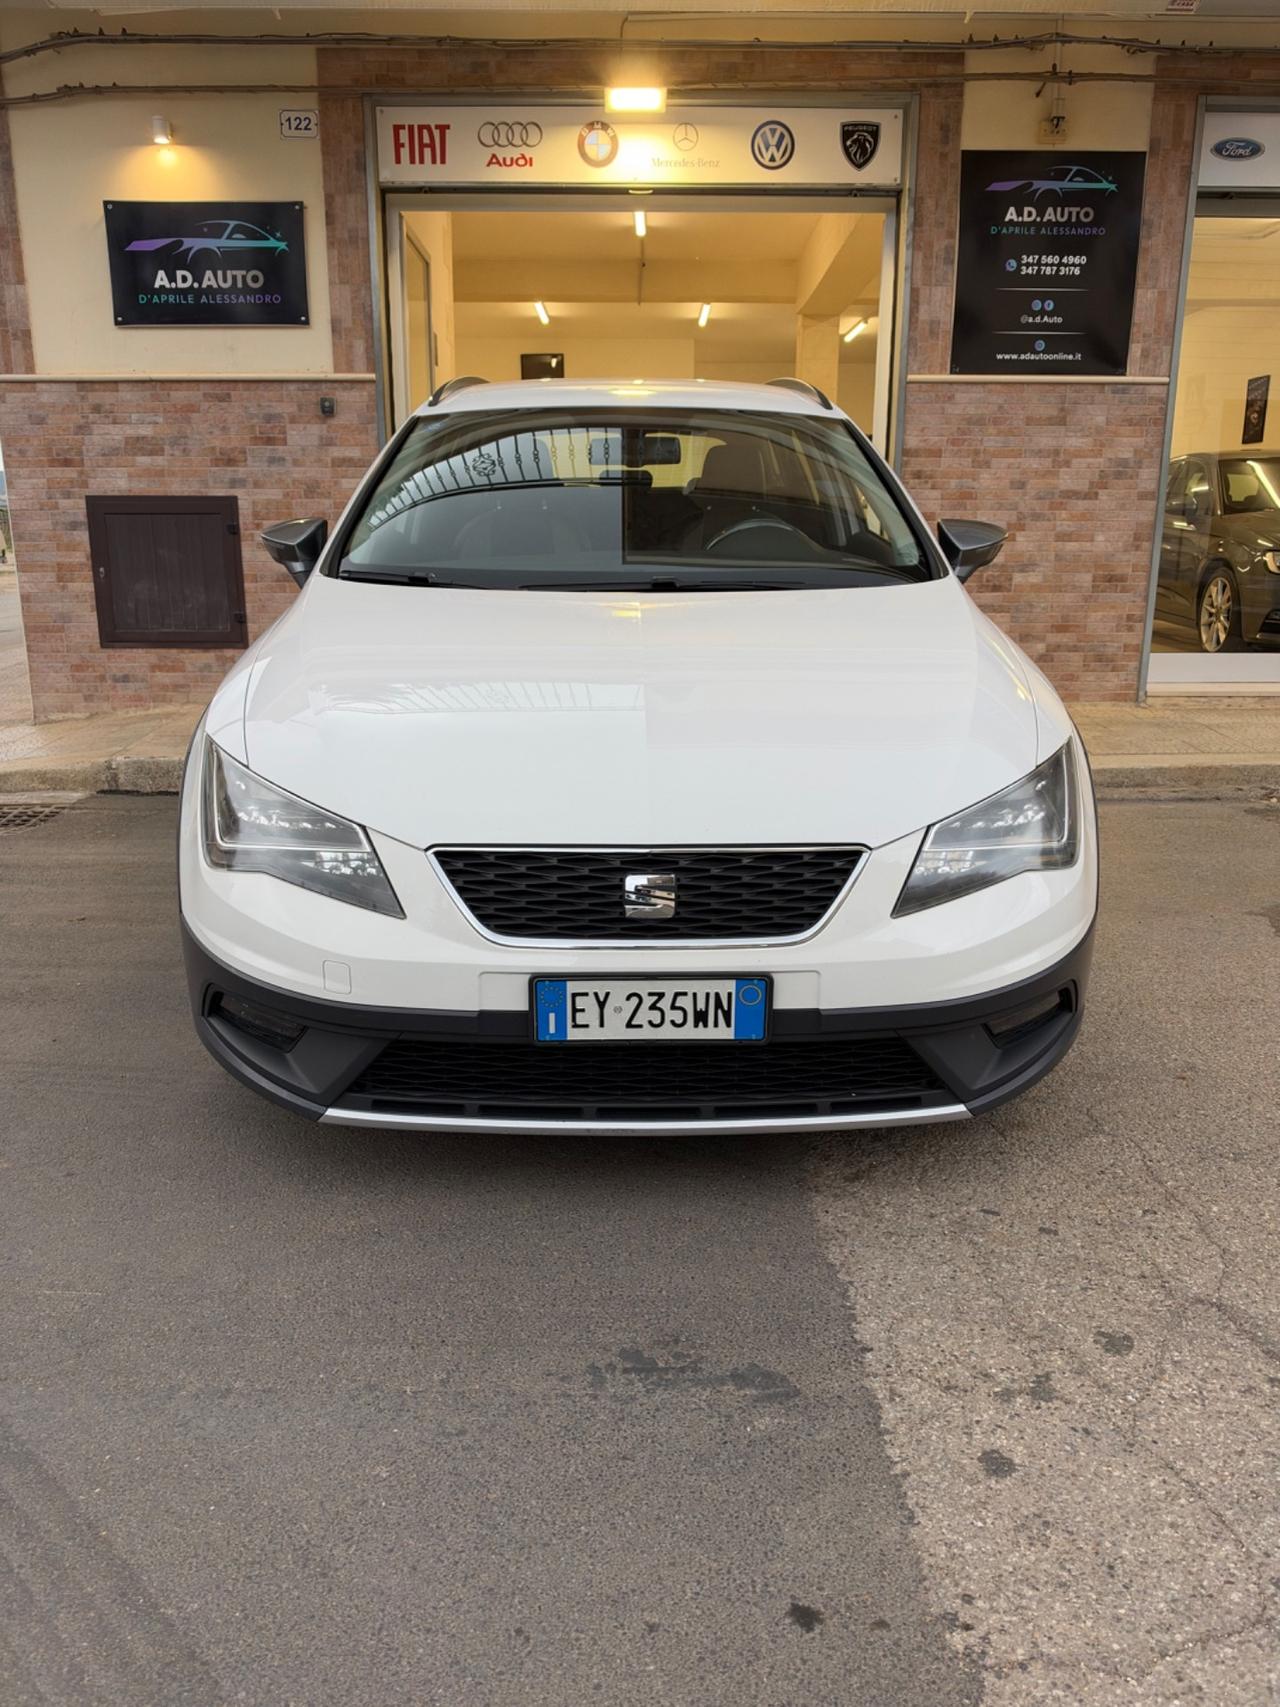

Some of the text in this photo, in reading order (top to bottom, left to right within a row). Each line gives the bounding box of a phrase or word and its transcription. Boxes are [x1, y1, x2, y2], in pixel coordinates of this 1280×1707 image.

[285, 116, 312, 131] 122
[392, 124, 451, 165] FIAT
[1222, 141, 1253, 156] Ford
[486, 153, 533, 167] Audi
[651, 157, 721, 168] Mercedes-Benz
[1004, 207, 1094, 223] A.D. AUTO
[991, 226, 1106, 236] D'APRILE ALESSANDRO
[1020, 255, 1087, 265] 347 560 4960
[1020, 266, 1080, 275] 347 787 3176
[154, 270, 264, 289] A.D. AUTO
[139, 294, 281, 304] D'APRILE ALESSANDRO
[1020, 315, 1063, 324] @a.d.Auto
[996, 352, 1081, 361] www.adautoonline.it
[571, 991, 611, 1028] EY
[625, 991, 733, 1028] 235WN
